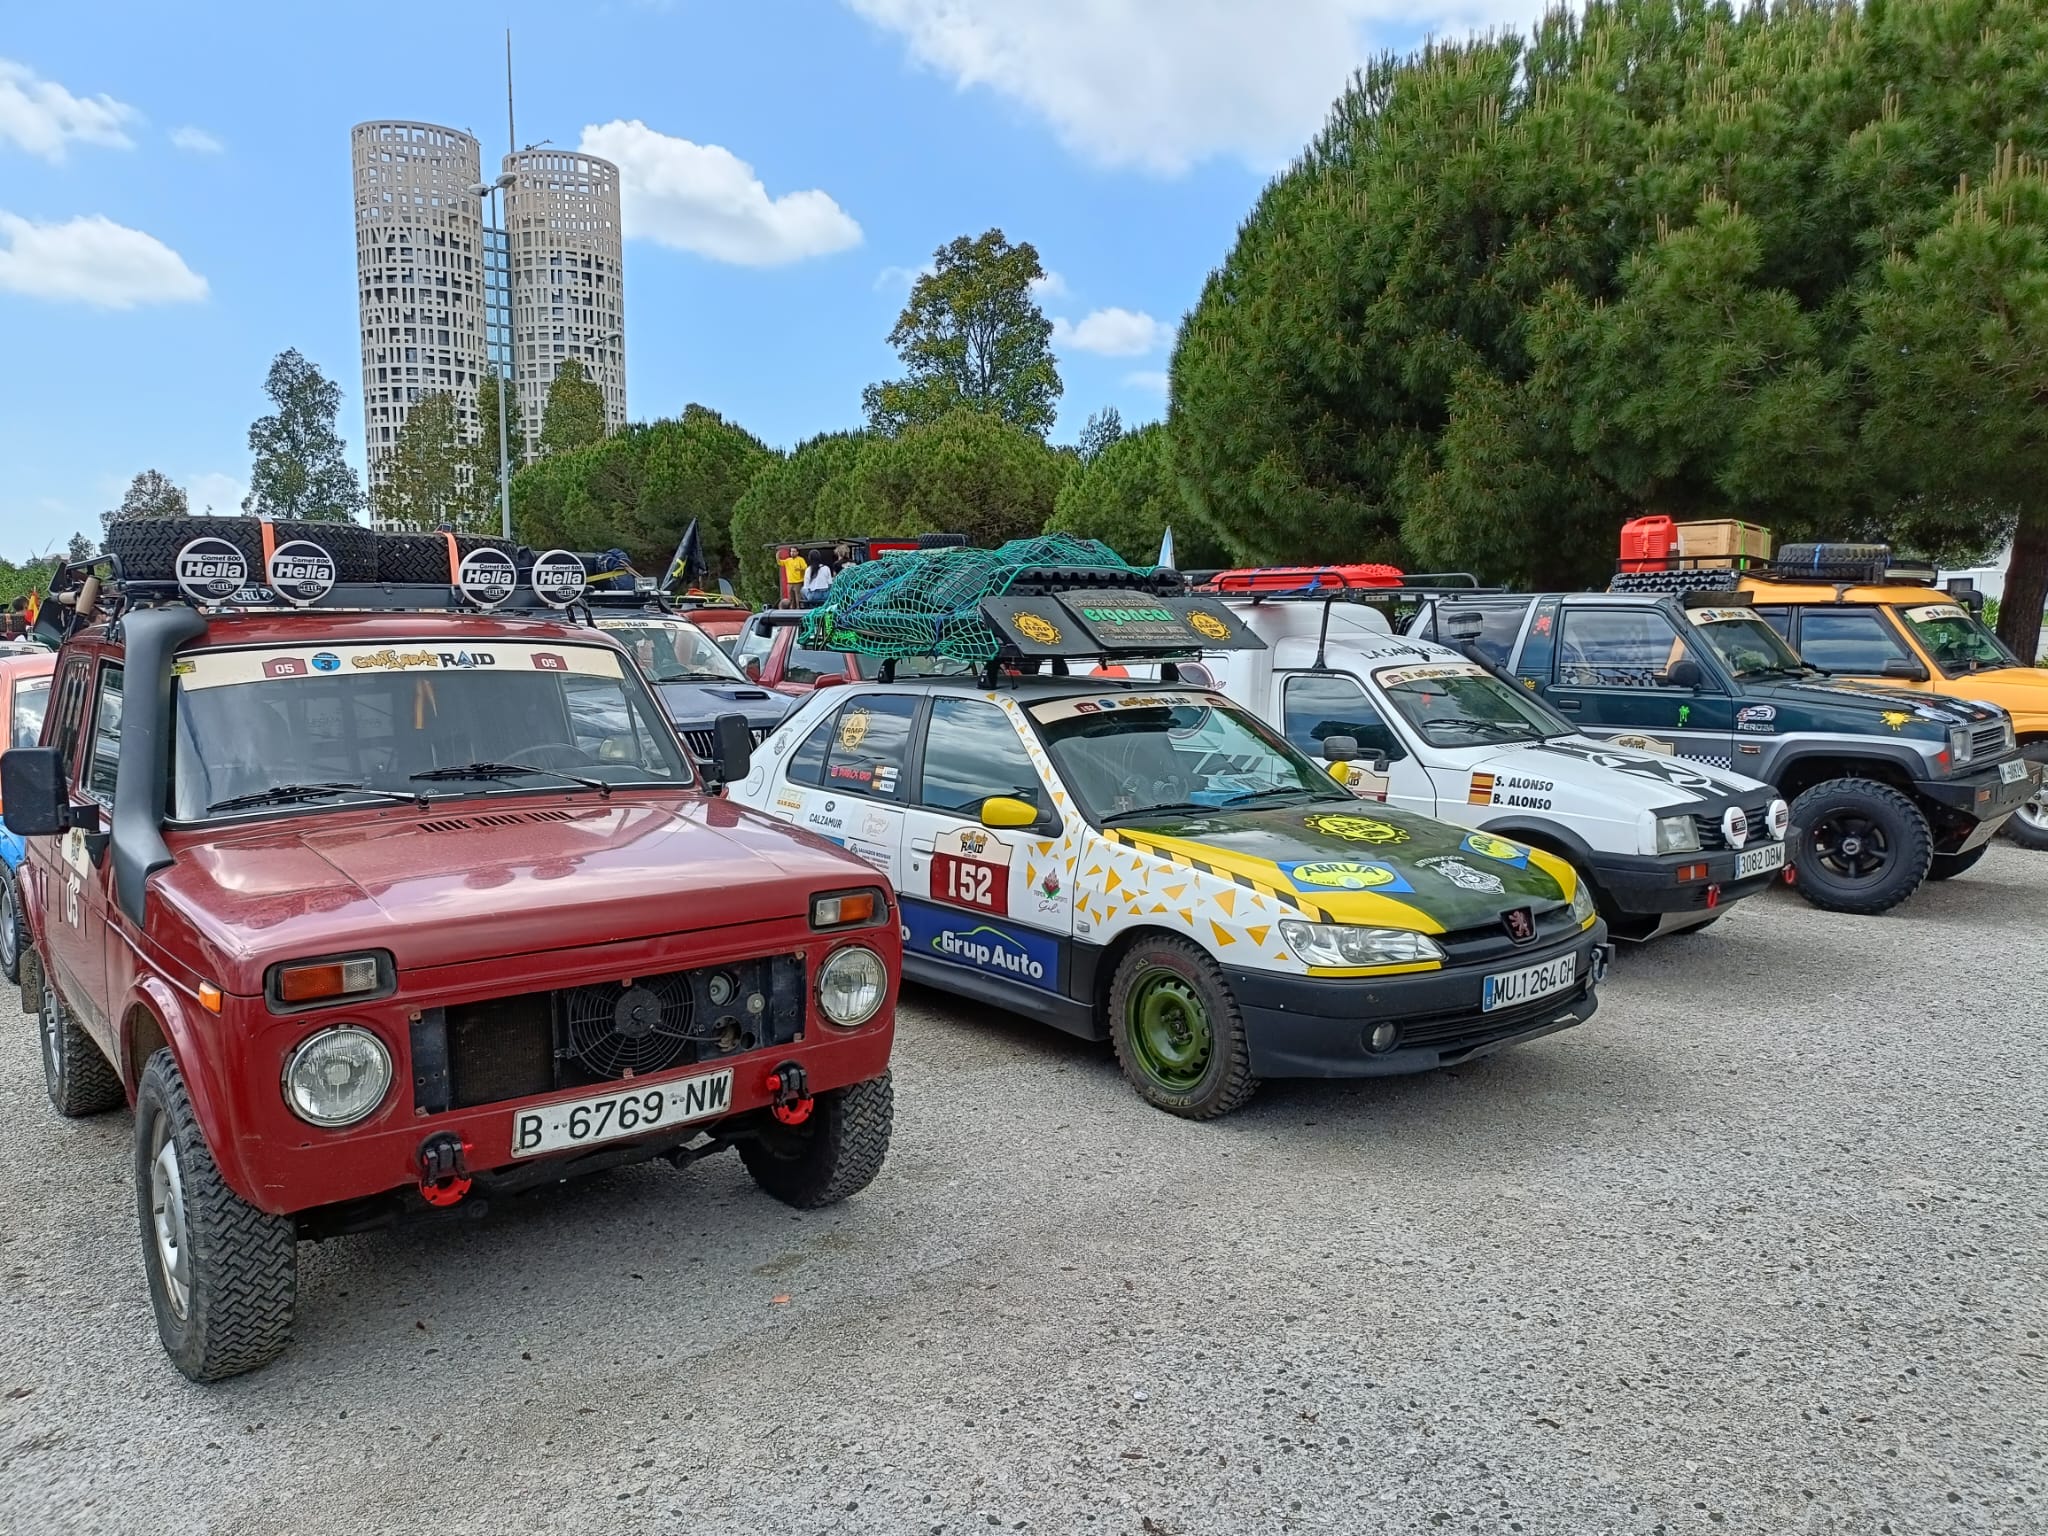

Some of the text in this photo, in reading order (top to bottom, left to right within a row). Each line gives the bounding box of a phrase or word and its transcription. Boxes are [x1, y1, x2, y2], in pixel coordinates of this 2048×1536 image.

[201, 554, 226, 562] Comet
[291, 556, 315, 564] Comet
[184, 562, 242, 578] Hella
[275, 563, 330, 580] Hella
[465, 569, 512, 584] Hella
[540, 571, 582, 585] Hella
[209, 582, 234, 591] HELLA
[1082, 608, 1176, 626] ergoncar
[320, 659, 333, 671] 3
[440, 651, 496, 668] RAID
[541, 658, 558, 668] 05
[275, 663, 295, 675] 05
[845, 727, 864, 735] RMP
[1495, 776, 1554, 792] S. ALONSO
[1492, 793, 1552, 810] B. ALONSO
[809, 813, 843, 830] CALZAMUR
[960, 840, 984, 855] RAID
[1741, 846, 1783, 874] 3082 DBM
[948, 860, 992, 906] 152
[66, 871, 81, 929] 05
[519, 1114, 543, 1150] B
